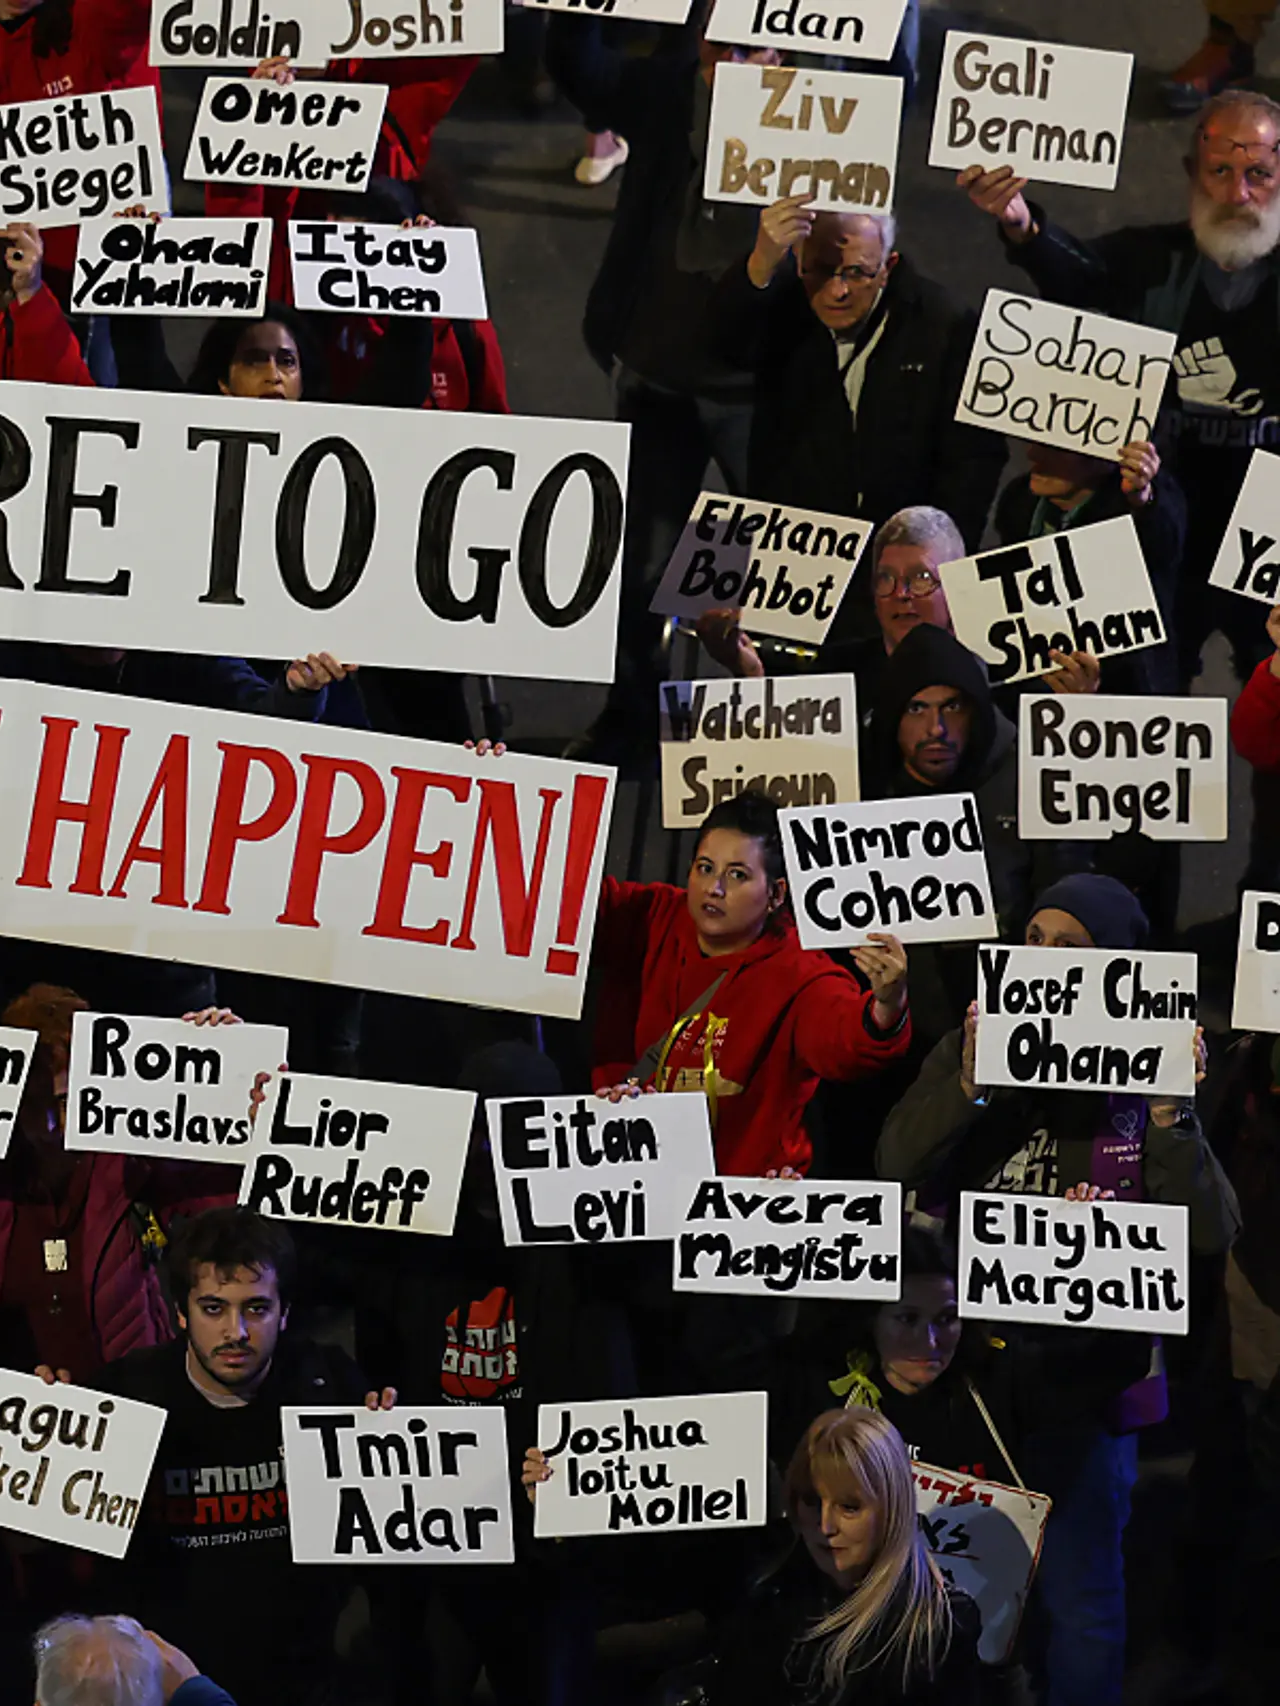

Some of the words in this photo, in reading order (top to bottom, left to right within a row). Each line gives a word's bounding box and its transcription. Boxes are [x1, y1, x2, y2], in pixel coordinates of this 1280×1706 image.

[160, 0, 302, 59] Goldin
[330, 0, 464, 55] Joshi
[759, 67, 859, 135] Ziv
[953, 39, 1054, 101] Gali
[946, 97, 1116, 165] Berman
[0, 145, 153, 217] Siegel
[719, 137, 891, 209] Berman
[101, 221, 259, 268] Ohad
[294, 224, 447, 273] Itay
[72, 257, 263, 313] Yahalomi
[317, 268, 440, 313] Chen
[985, 298, 1173, 389] Sahar
[963, 355, 1151, 447] Baruch
[187, 423, 377, 612] TO
[414, 444, 625, 628] GO
[696, 499, 860, 561] Elekana
[678, 549, 835, 621] Bohbot
[976, 536, 1083, 615] Tal
[989, 606, 1161, 685] Shoham
[665, 677, 841, 743] Watchara
[1030, 700, 1212, 760] Ronen
[1039, 769, 1191, 833] Engel
[16, 716, 609, 978] HAPPEN!
[791, 799, 983, 871] Nimrod
[804, 875, 986, 932] Cohen
[979, 950, 1082, 1019] Yosef
[1102, 958, 1197, 1020] Chaim
[89, 1017, 222, 1085] Rom
[1007, 1021, 1164, 1085] Ohana
[78, 1087, 249, 1146] Braslavs
[270, 1080, 388, 1152] Lior
[499, 1100, 658, 1170] Eitan
[248, 1153, 430, 1226] Rudeff
[510, 1177, 646, 1244] Levi
[686, 1180, 882, 1226] Avera
[680, 1232, 897, 1291] Mengistu
[972, 1198, 1166, 1269] Eliyhu
[967, 1258, 1185, 1321] Margalit
[298, 1414, 479, 1479] Tmir
[544, 1410, 708, 1457] Joshua
[62, 1468, 138, 1530] Chen
[334, 1483, 499, 1555] Adar
[608, 1479, 748, 1531] Mollel
